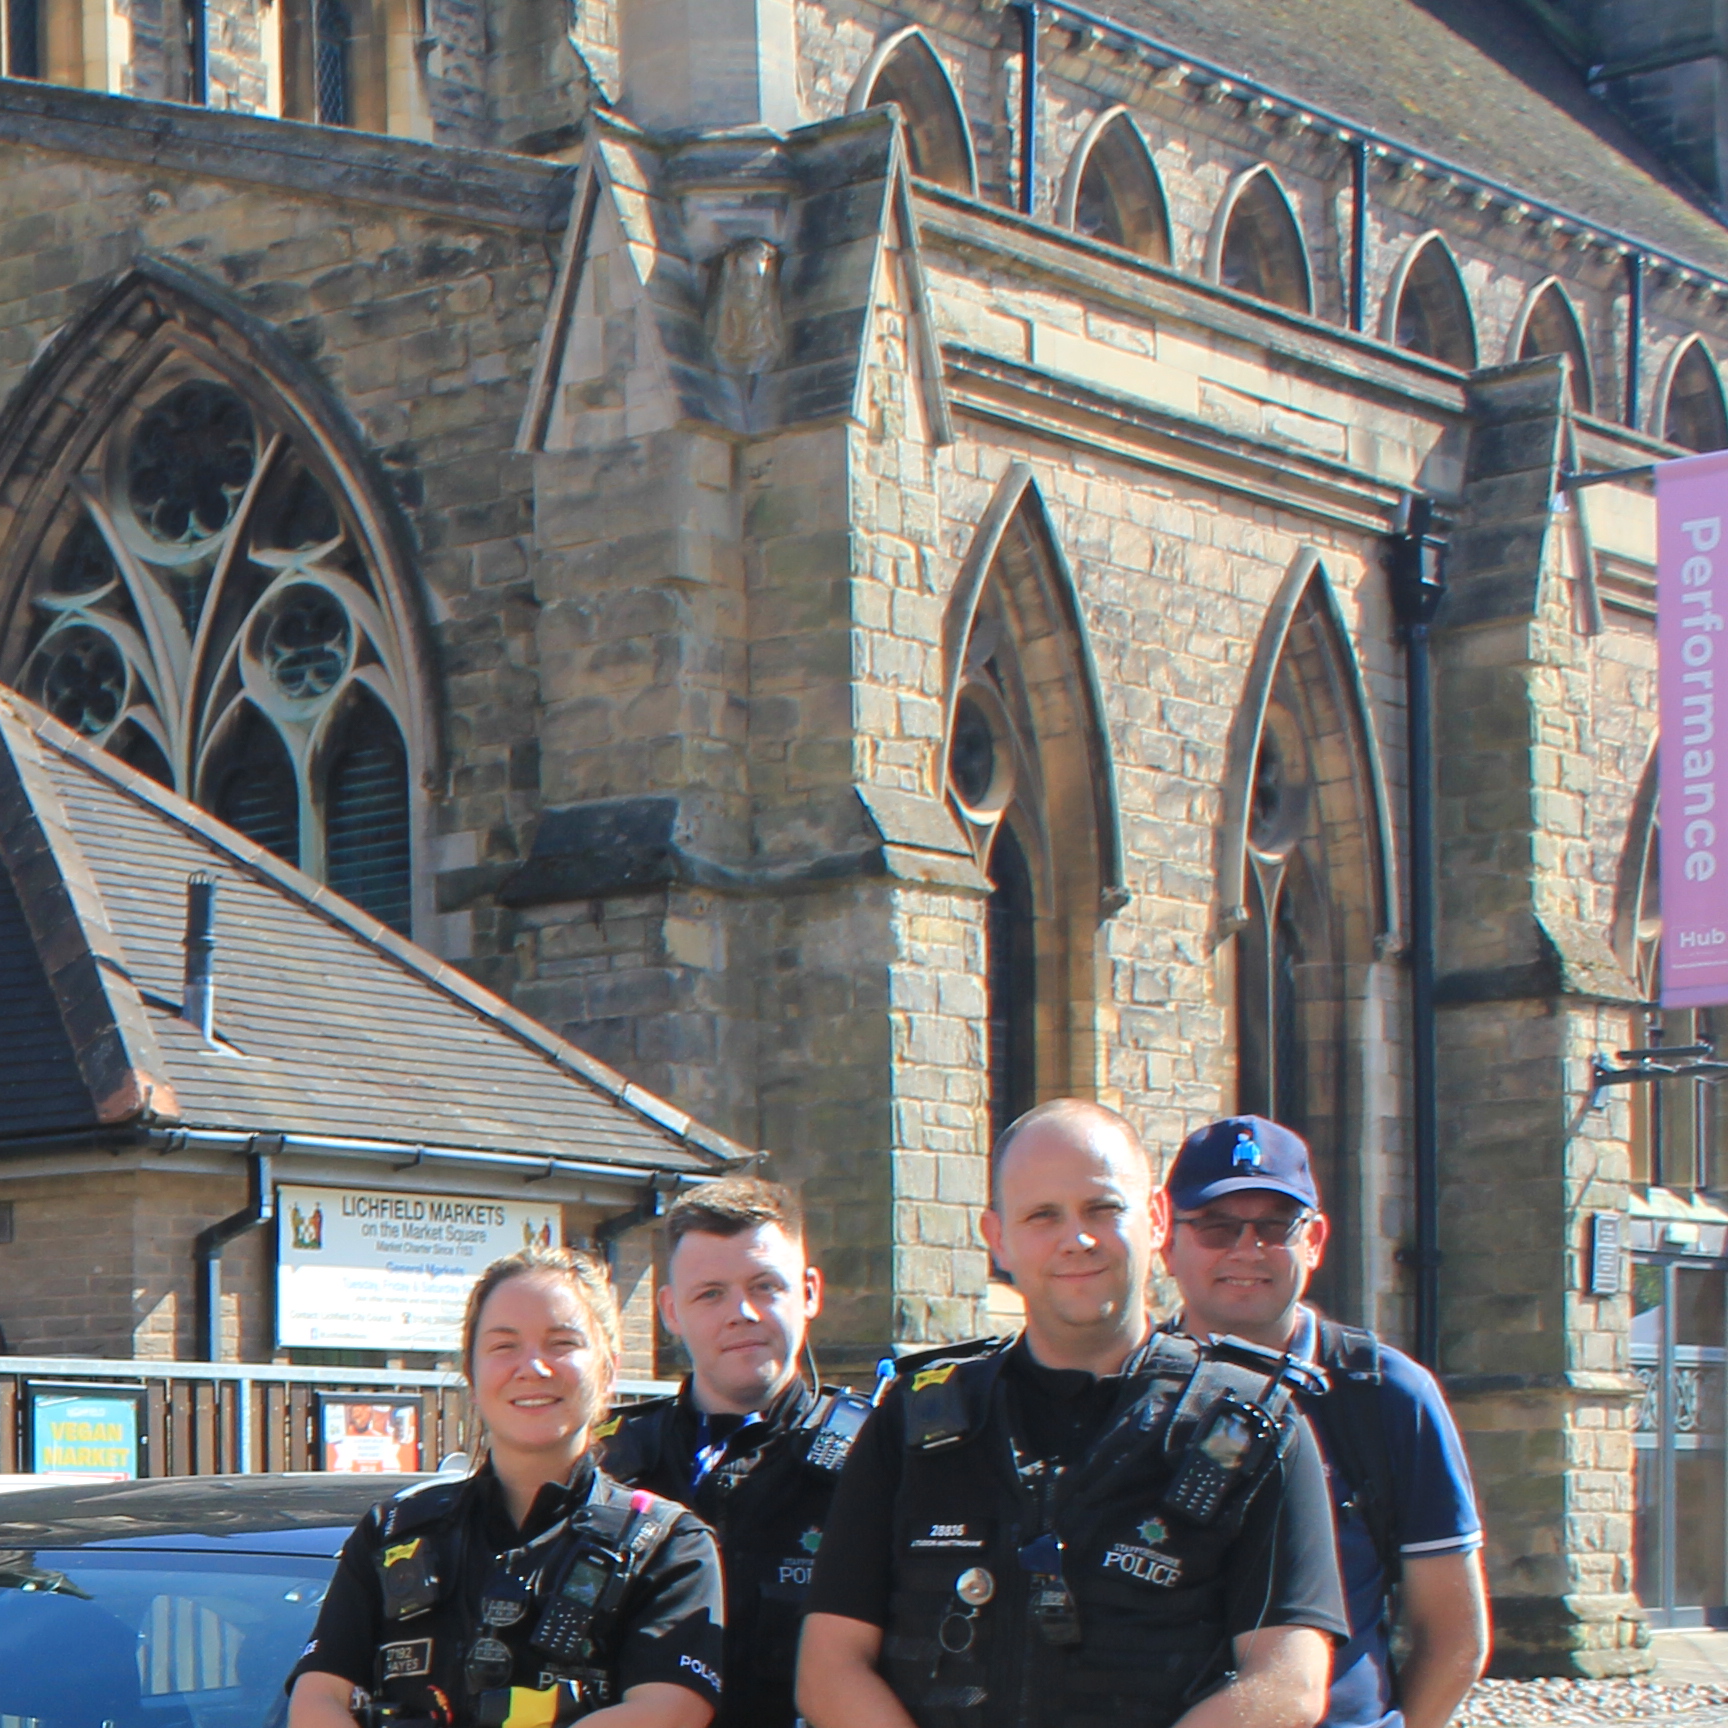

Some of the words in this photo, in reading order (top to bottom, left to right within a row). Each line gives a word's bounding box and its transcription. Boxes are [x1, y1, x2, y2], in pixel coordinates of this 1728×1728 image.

[1681, 516, 1724, 882] Performance
[1679, 927, 1726, 948] Hub
[341, 1195, 424, 1221] LICHFIELD
[429, 1202, 505, 1227] MARKETS
[361, 1223, 377, 1237] on
[380, 1221, 400, 1239] the
[402, 1222, 443, 1241] Market
[445, 1225, 487, 1244] Square
[376, 1240, 403, 1252] Market
[403, 1242, 433, 1254] Charter
[433, 1244, 454, 1255] Since
[386, 1261, 424, 1274] General
[425, 1263, 465, 1275] Markets
[49, 1421, 123, 1442] VEGAN
[43, 1445, 131, 1467] MARKET
[1102, 1550, 1183, 1588] POLICE
[679, 1654, 723, 1693] POLICE
